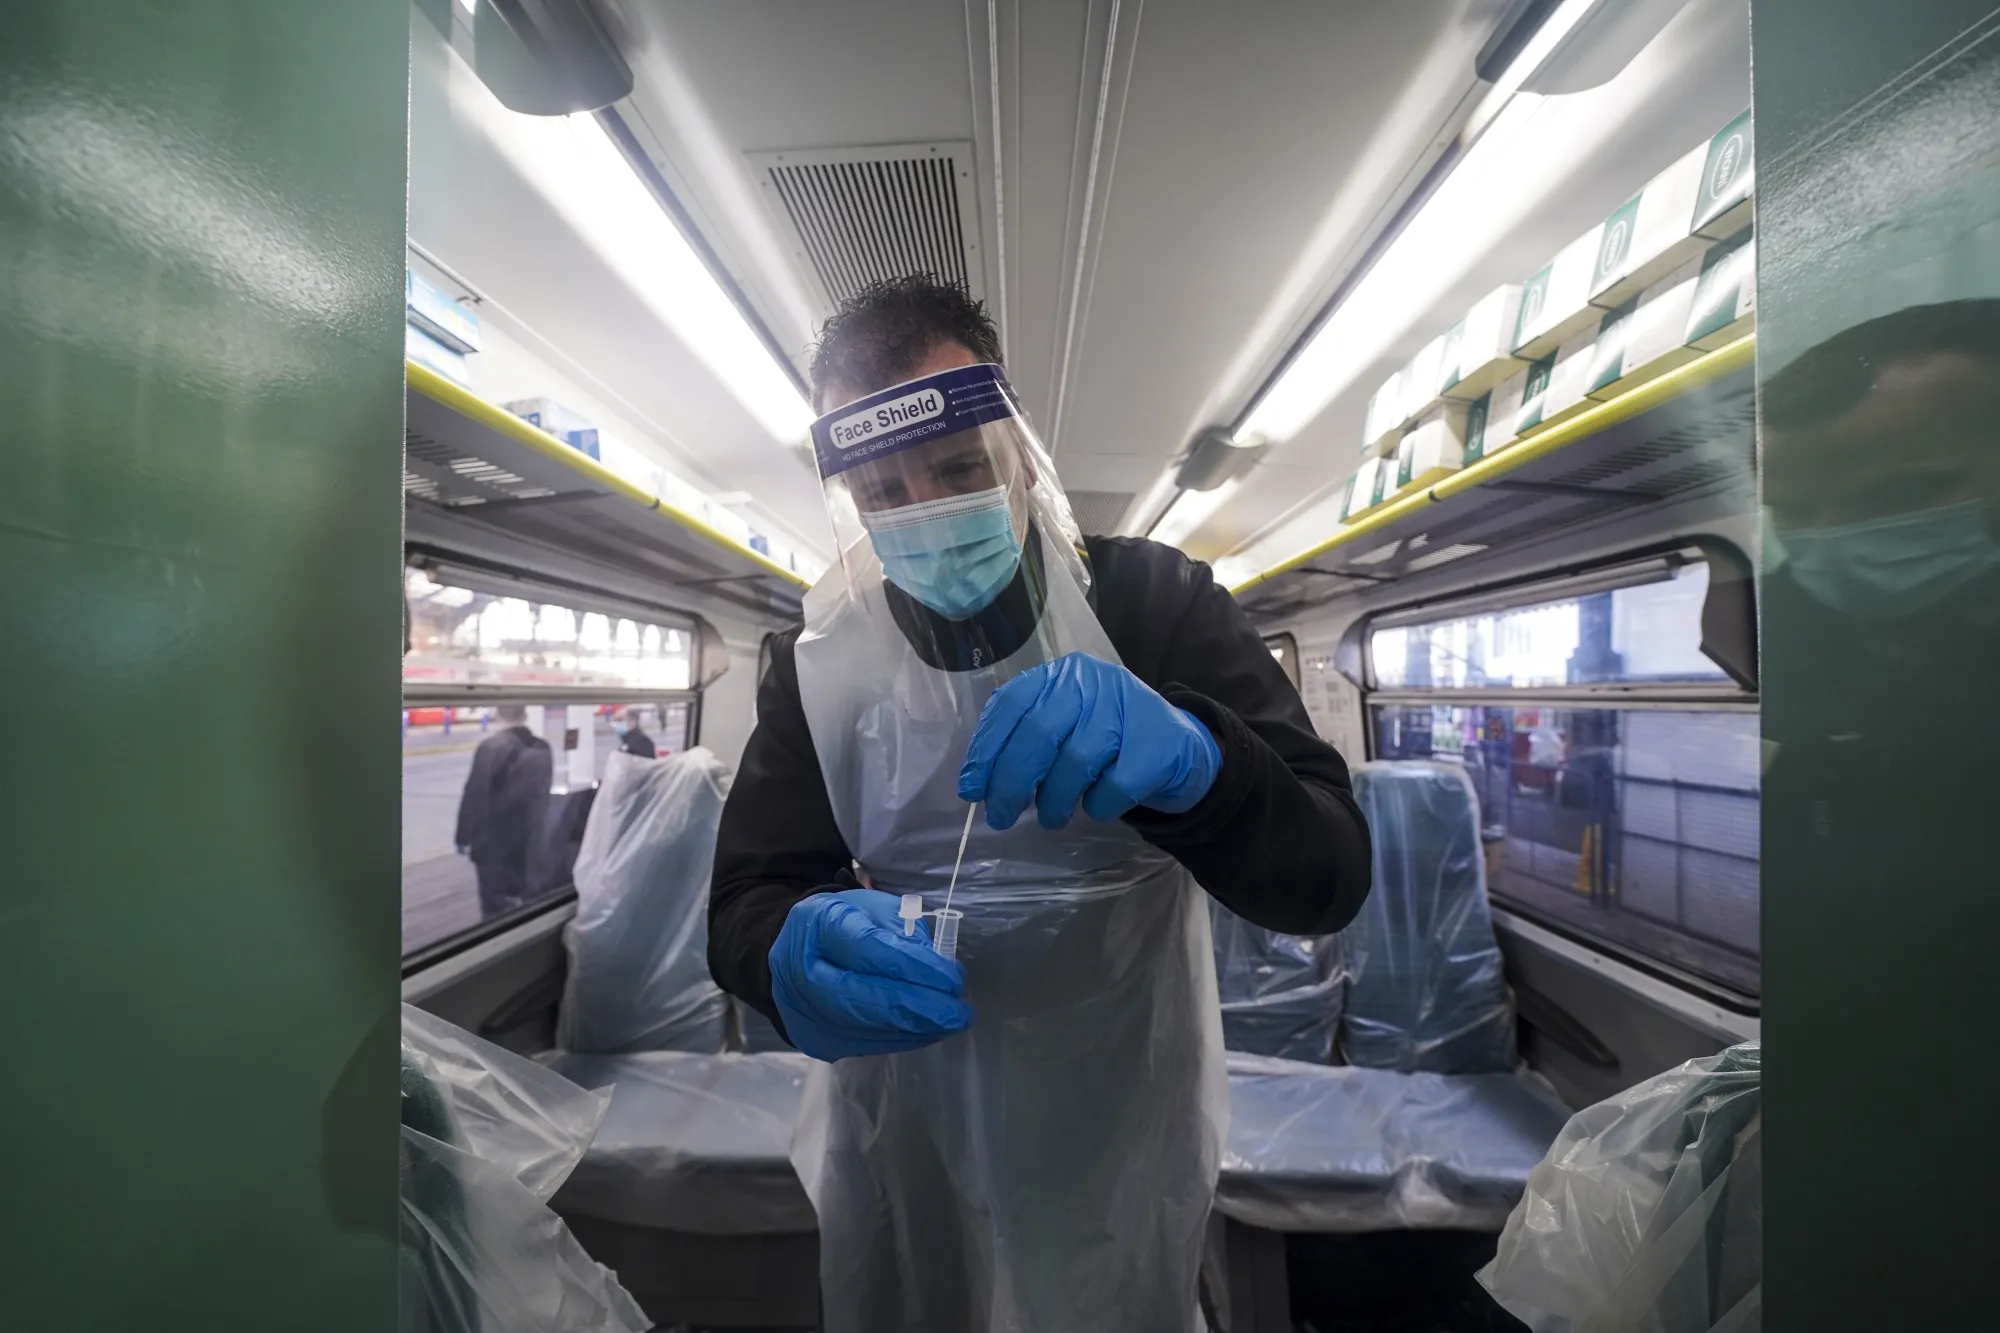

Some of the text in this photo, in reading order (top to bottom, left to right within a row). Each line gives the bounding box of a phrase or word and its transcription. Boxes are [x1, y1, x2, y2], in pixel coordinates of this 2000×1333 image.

[834, 420, 873, 445] Face
[876, 394, 938, 428] Shield
[851, 446, 869, 458] FACE
[868, 437, 895, 453] SHIELD
[895, 421, 947, 443] PROTECTION
